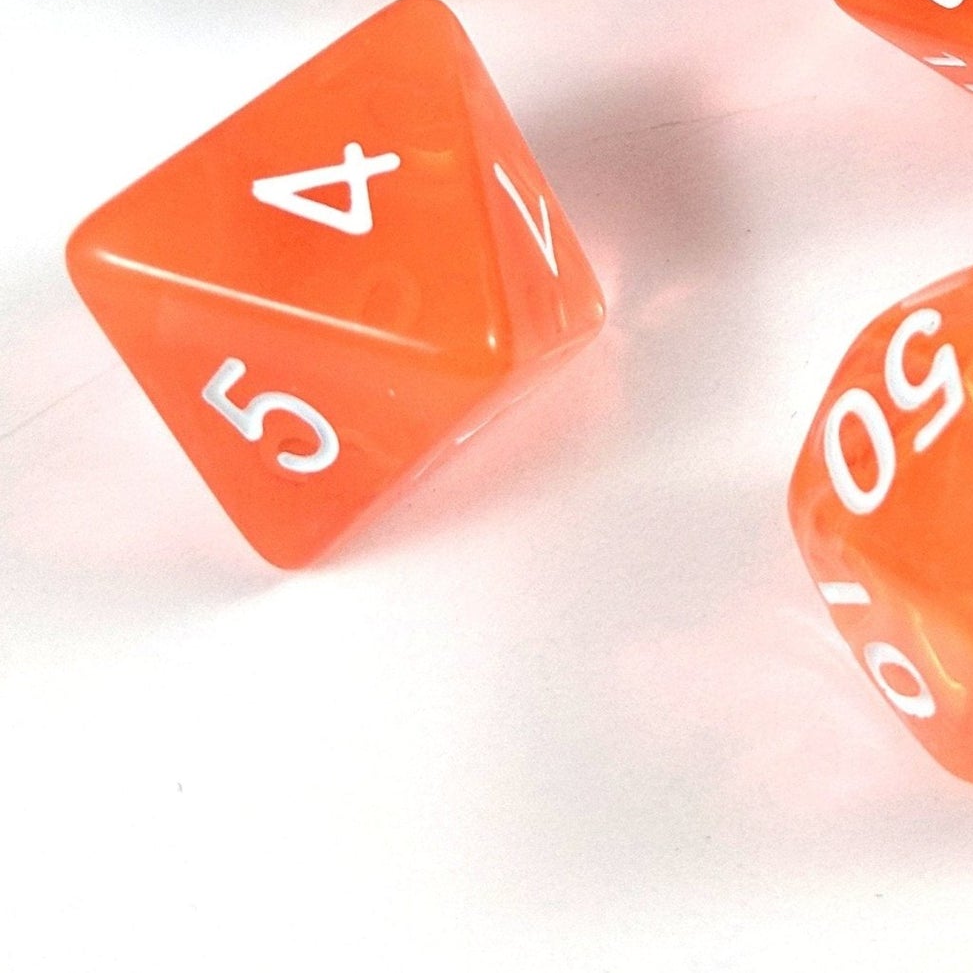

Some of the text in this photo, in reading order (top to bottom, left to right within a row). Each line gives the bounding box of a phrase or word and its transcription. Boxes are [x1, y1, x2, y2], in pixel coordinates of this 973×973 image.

[251, 141, 401, 235] 4
[201, 356, 340, 474] 5
[823, 308, 965, 516] 50
